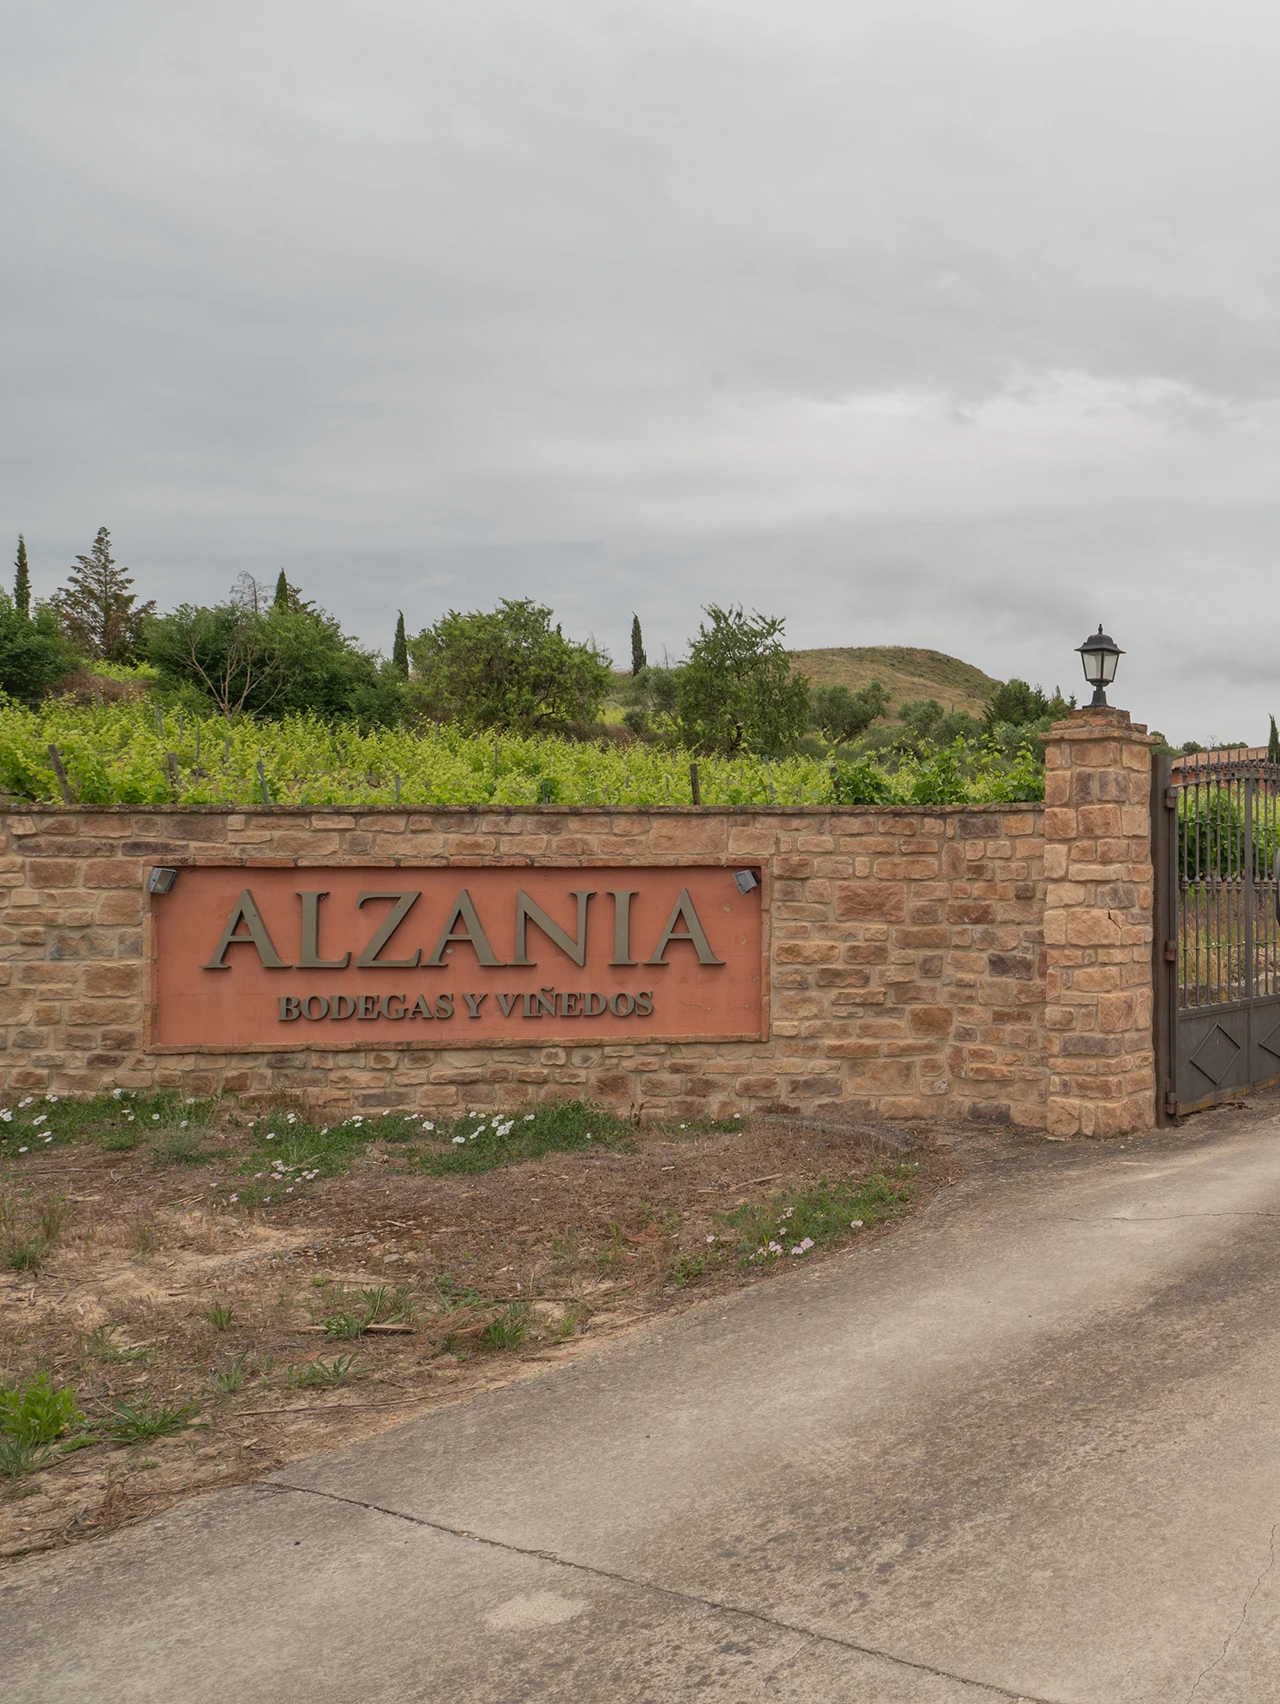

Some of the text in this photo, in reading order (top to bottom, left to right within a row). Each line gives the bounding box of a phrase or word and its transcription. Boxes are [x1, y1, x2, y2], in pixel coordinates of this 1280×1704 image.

[203, 889, 726, 969] ALZANIA
[277, 987, 654, 1021] BODEGAS Y VIÑEDOS
